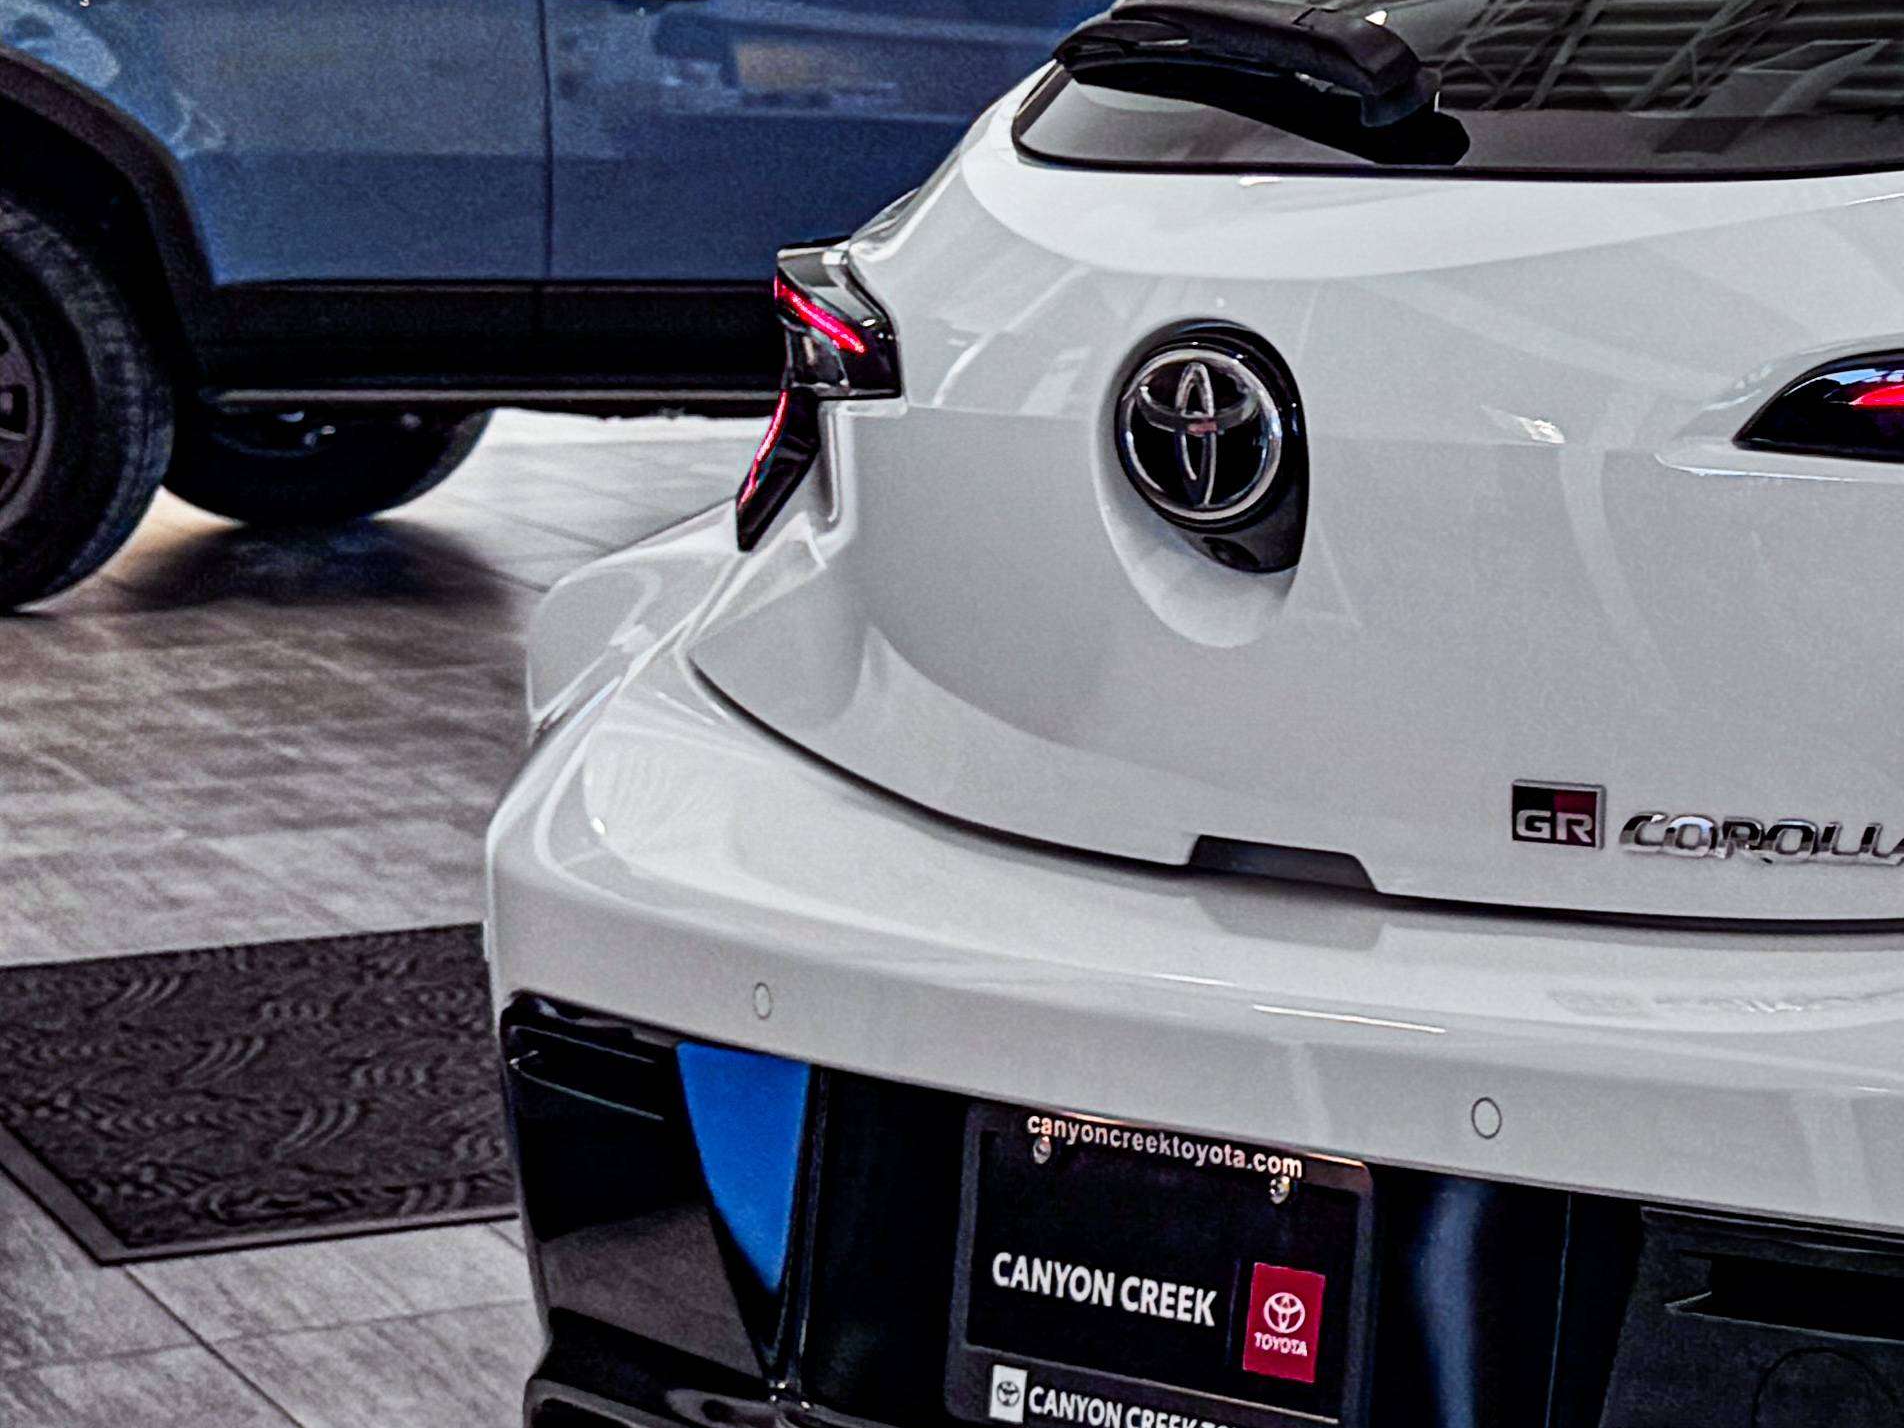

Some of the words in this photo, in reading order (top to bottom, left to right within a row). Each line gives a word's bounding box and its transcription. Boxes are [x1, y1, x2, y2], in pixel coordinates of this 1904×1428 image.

[1516, 809, 1592, 843] GR
[1027, 1115, 1303, 1178] canyoncreektoyota.com
[992, 1252, 1116, 1308] CANYON
[1119, 1275, 1217, 1327] CREEK
[1253, 1331, 1308, 1357] TOYOTA
